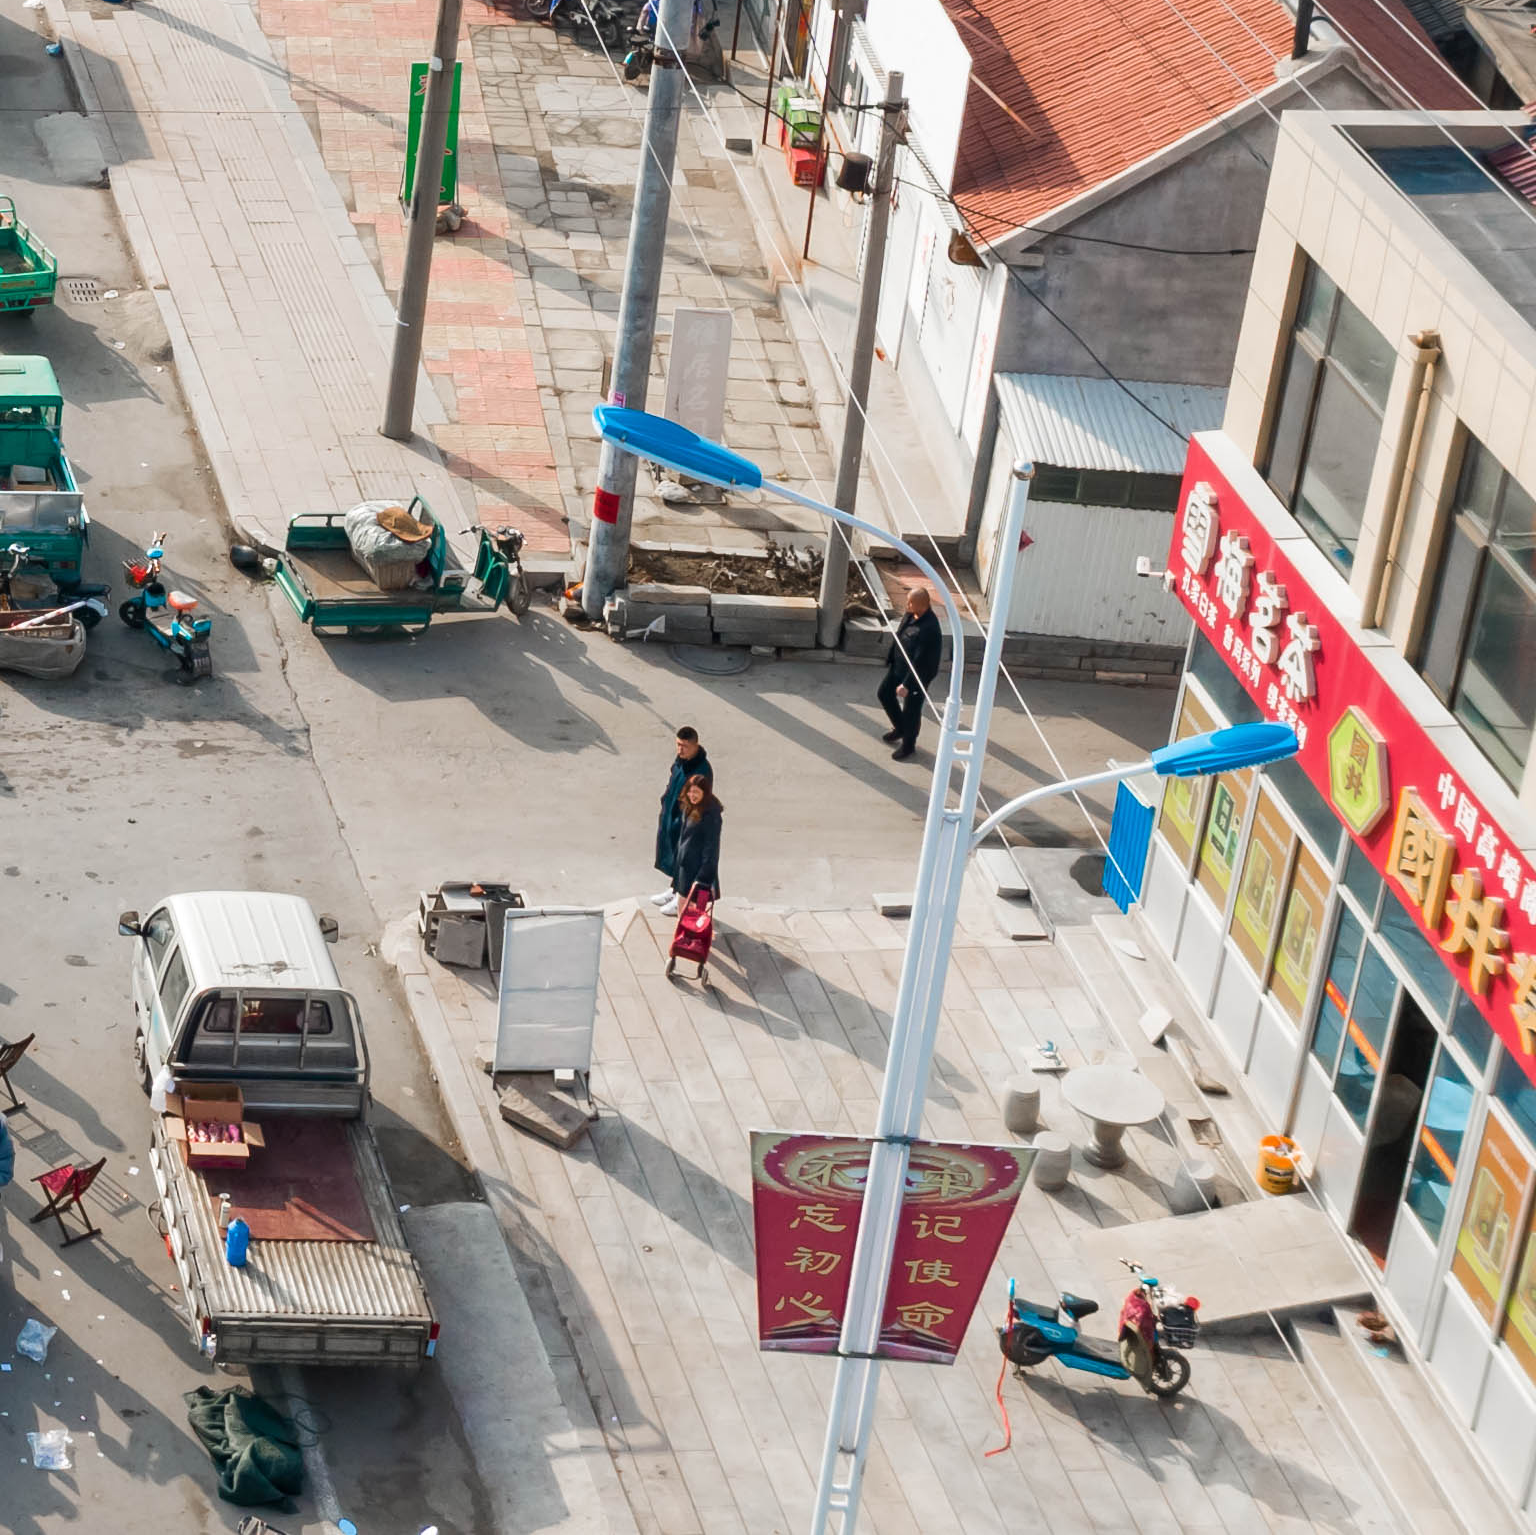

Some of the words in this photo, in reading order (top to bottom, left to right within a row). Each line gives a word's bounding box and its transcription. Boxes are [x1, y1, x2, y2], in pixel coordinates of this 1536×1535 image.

[774, 1157, 858, 1319] 不忘初心
[896, 1167, 983, 1330] 牢记使命
